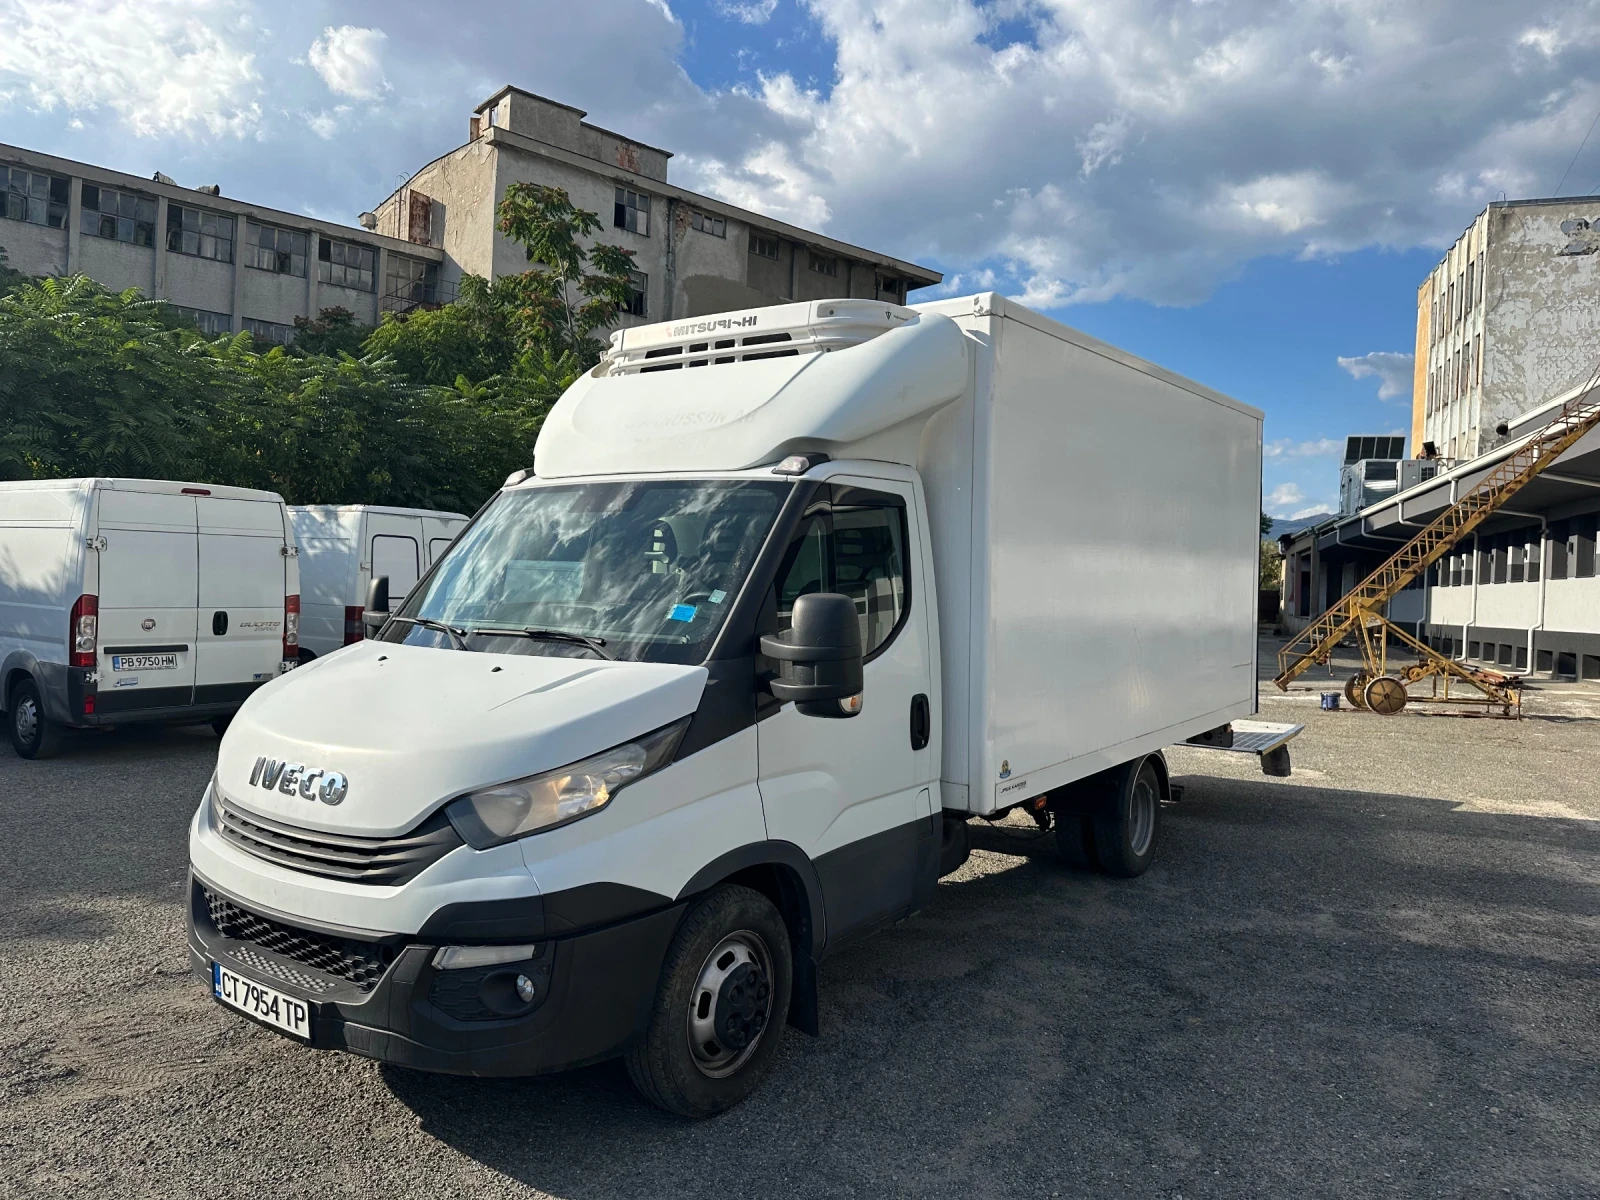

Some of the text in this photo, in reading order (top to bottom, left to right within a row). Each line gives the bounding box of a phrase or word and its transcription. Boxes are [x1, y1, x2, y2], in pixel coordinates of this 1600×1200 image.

[120, 655, 175, 668] PB 9750 HM
[249, 756, 349, 806] IVECO
[222, 971, 307, 1030] CT 7954 TP
